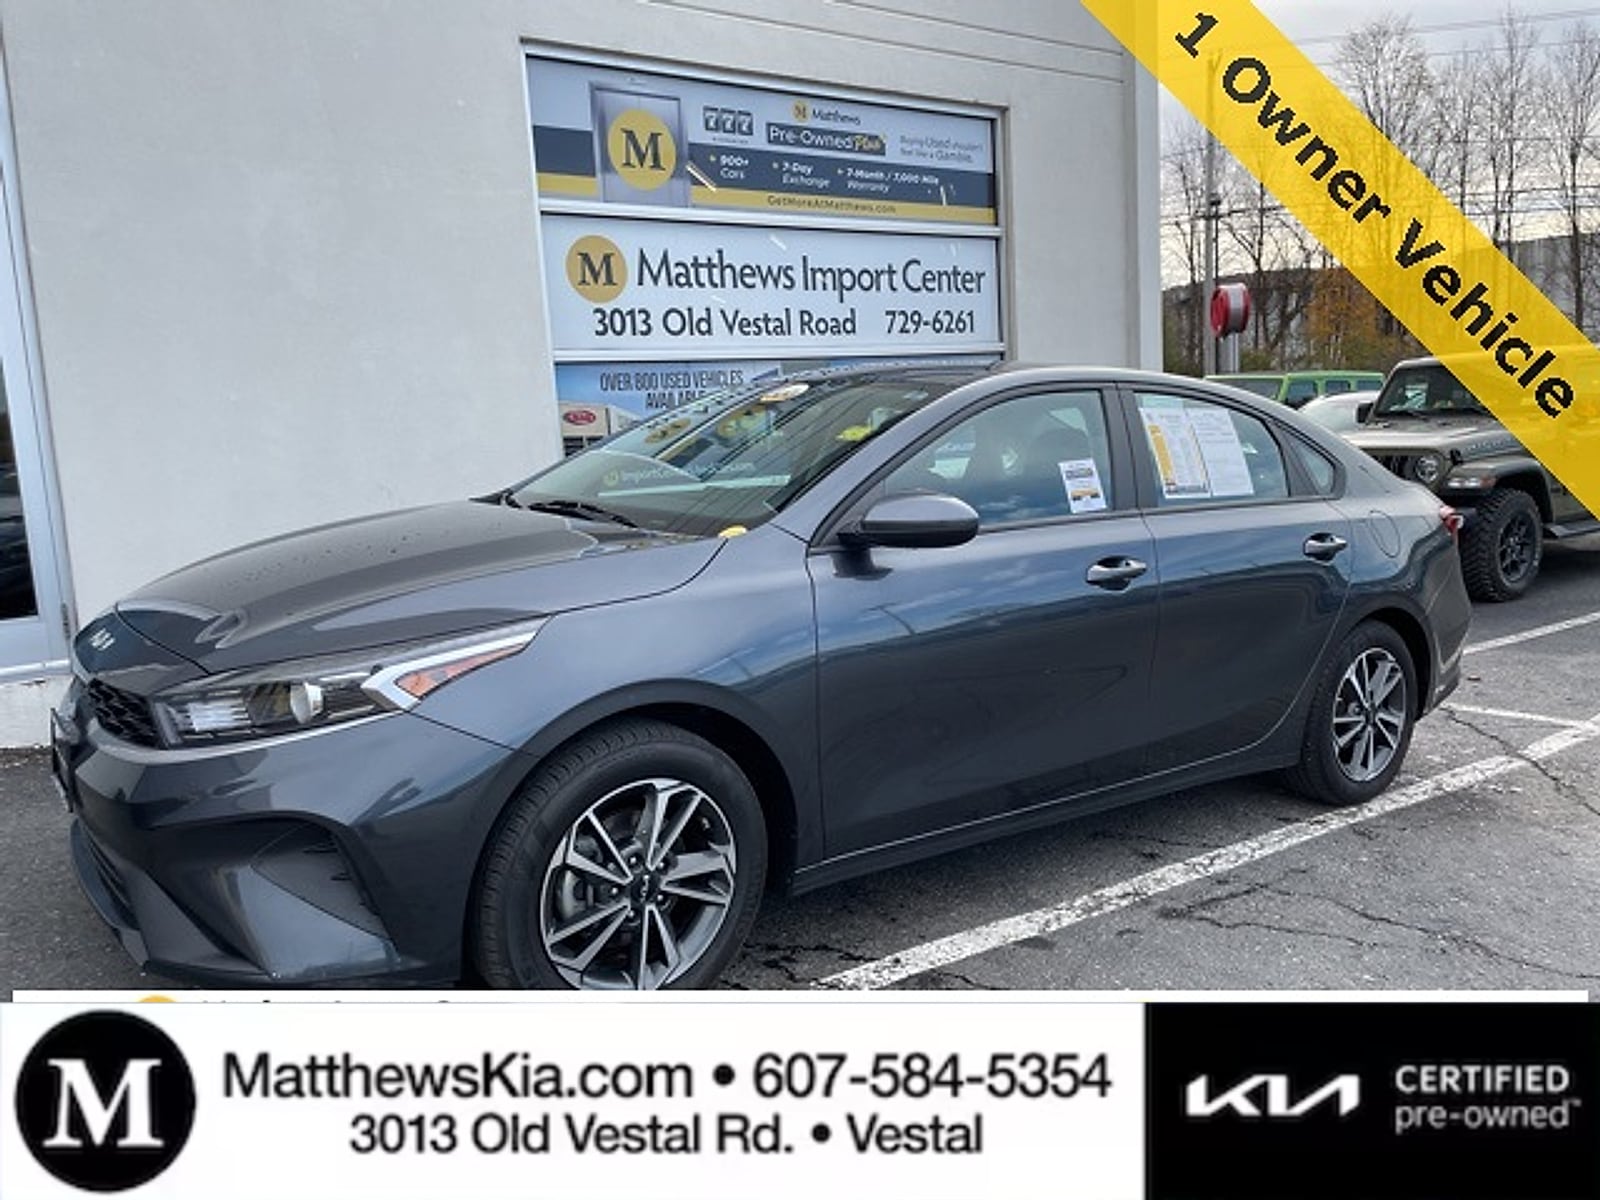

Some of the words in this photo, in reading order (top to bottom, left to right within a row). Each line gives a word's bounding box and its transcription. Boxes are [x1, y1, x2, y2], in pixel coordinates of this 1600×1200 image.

[812, 107, 861, 126] Matthews
[621, 127, 666, 171] M
[769, 125, 853, 149] Pre-Owned
[578, 252, 619, 287] M
[637, 248, 796, 290] Matthews
[802, 255, 898, 304] Import
[902, 258, 986, 294] Center
[593, 307, 652, 336] 3013
[662, 307, 713, 336] Old
[720, 307, 792, 336] Vestal
[799, 307, 857, 336] Road
[885, 309, 974, 334] 729-6261
[600, 372, 633, 391] OVER
[660, 372, 692, 390] USED
[693, 370, 745, 389] VEHICLES
